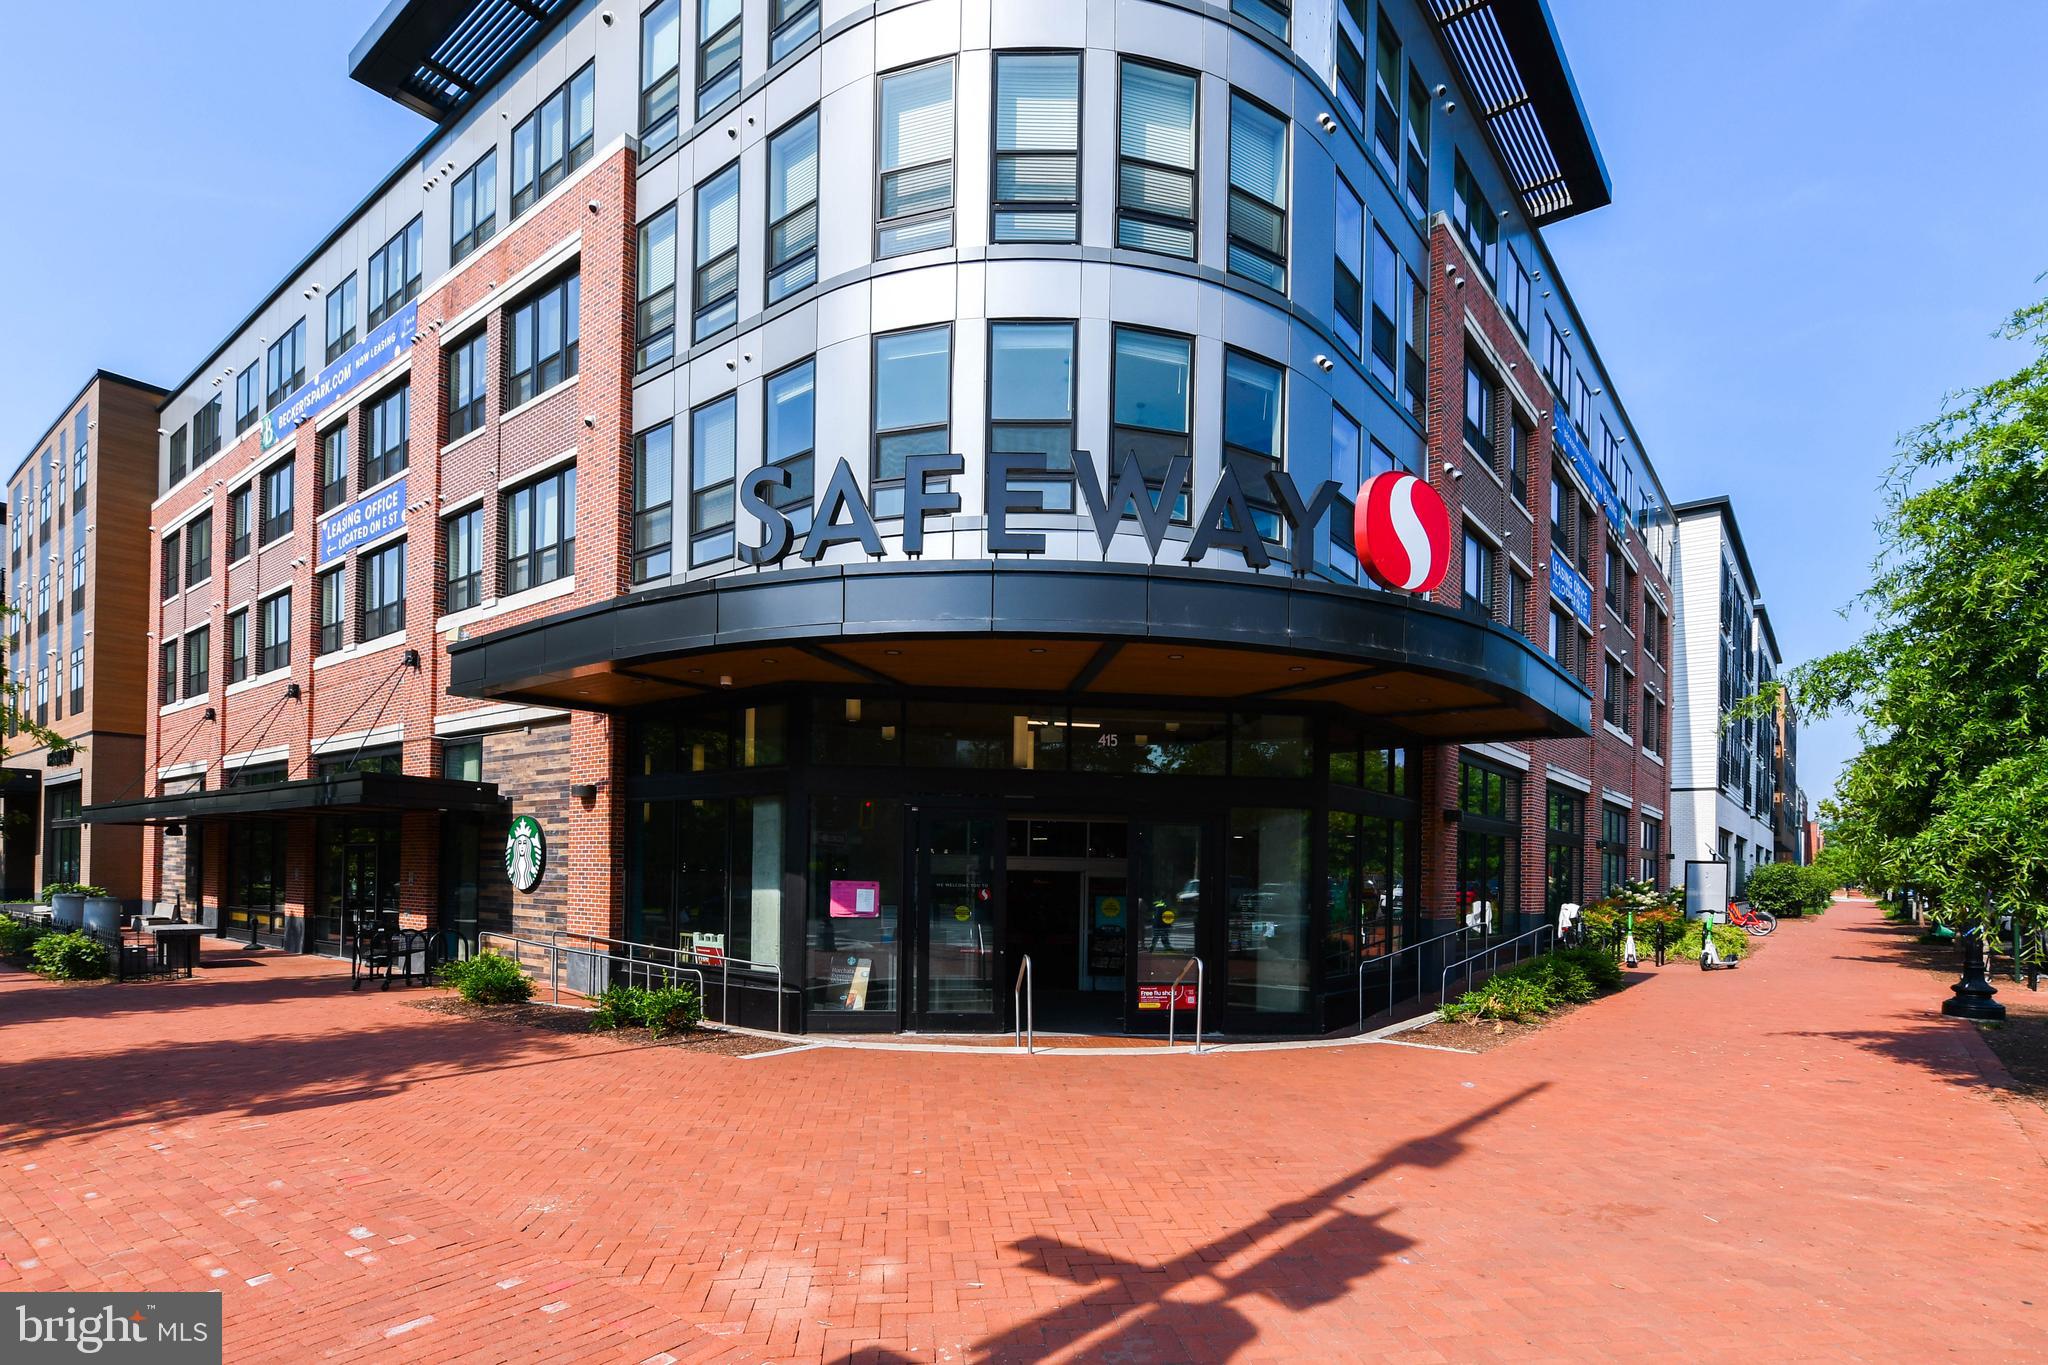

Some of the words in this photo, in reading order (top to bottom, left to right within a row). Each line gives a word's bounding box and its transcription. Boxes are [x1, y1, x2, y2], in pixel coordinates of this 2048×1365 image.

[355, 353, 369, 370] NOW
[370, 332, 396, 359] LEASING
[327, 508, 361, 540] LEASING
[365, 490, 398, 520] OFFICE
[338, 525, 368, 550] LOCATED
[370, 519, 380, 534] ON
[382, 515, 387, 529] E
[388, 510, 398, 526] ST
[737, 449, 1342, 575] SAFEWAY
[1098, 733, 1118, 748] 415
